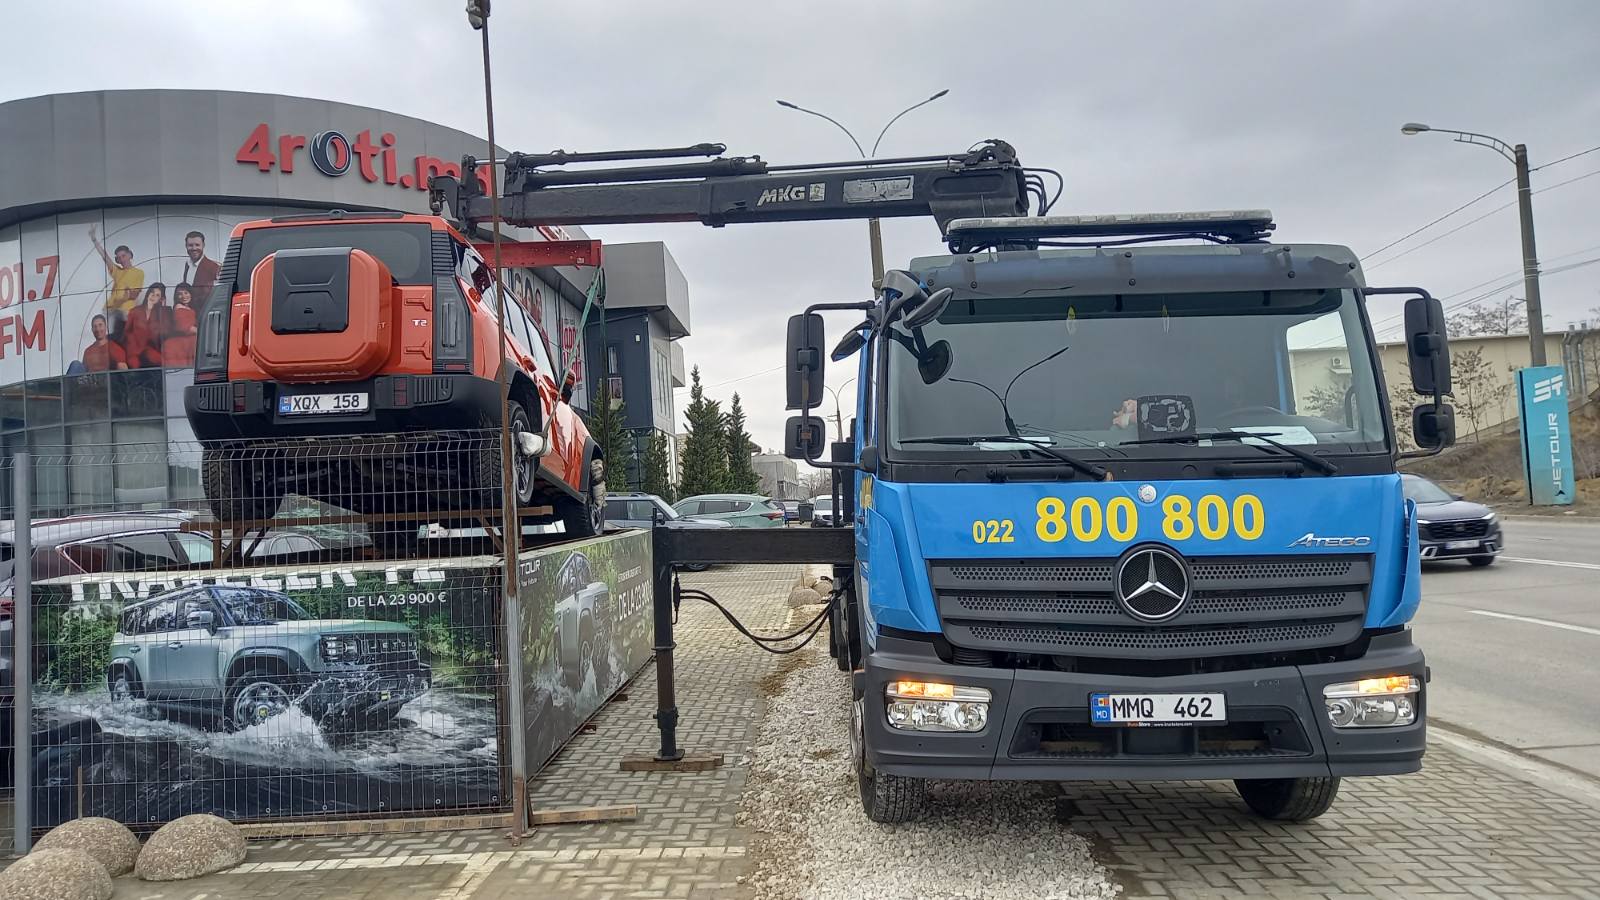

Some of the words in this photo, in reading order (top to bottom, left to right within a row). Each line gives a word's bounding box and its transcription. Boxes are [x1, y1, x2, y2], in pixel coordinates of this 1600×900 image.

[236, 123, 494, 197] 4roti.m
[756, 184, 806, 207] MKG
[0, 309, 47, 360] FM
[411, 319, 428, 327] T2
[293, 396, 321, 411] XQX
[333, 394, 360, 409] 158
[1548, 412, 1562, 492] JETOUR
[971, 519, 1015, 544] 022
[1035, 496, 1139, 542] 800
[1161, 494, 1265, 541] 800
[347, 596, 366, 608] DE
[368, 595, 387, 607] LA
[389, 594, 406, 606] 23
[408, 592, 435, 604] 900
[618, 591, 627, 621] DE
[1112, 697, 1154, 719] MMQ
[1173, 697, 1213, 718] 462
